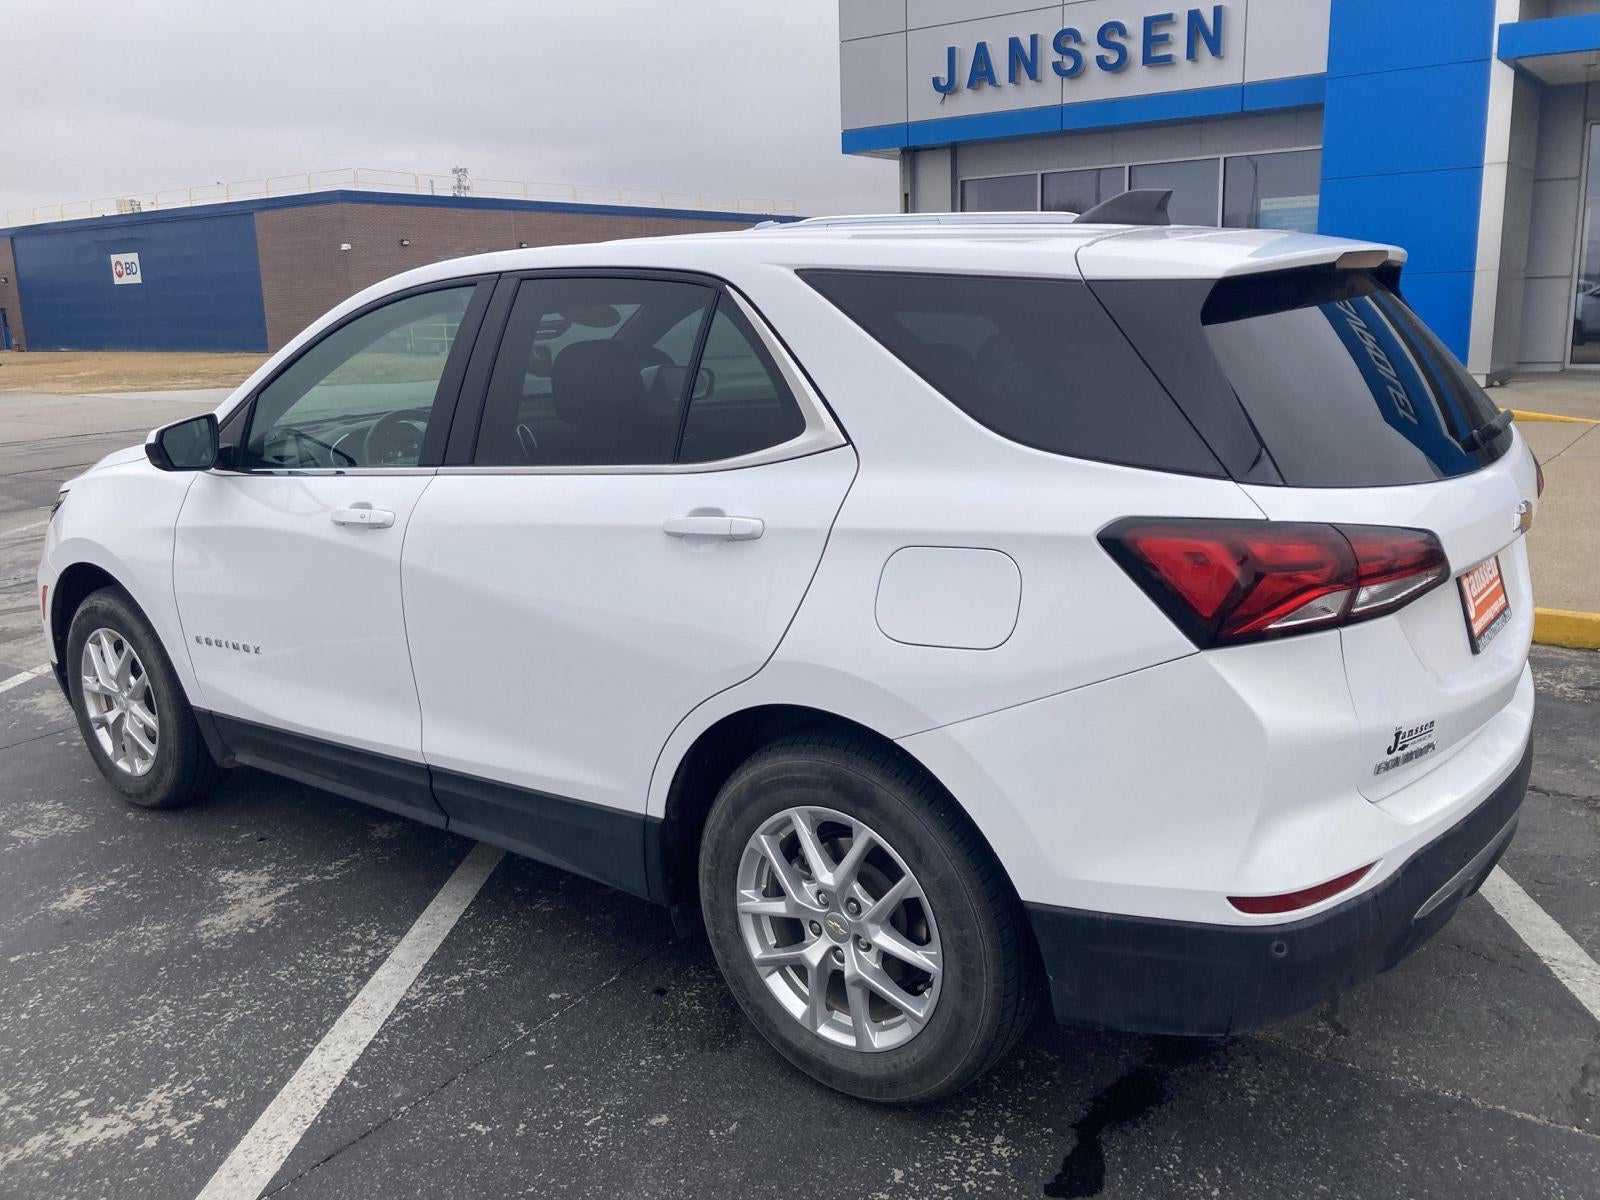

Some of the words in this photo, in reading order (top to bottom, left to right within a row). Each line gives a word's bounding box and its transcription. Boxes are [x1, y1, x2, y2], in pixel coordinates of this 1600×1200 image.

[932, 4, 1224, 94] JANSSEN
[125, 261, 138, 276] BD
[195, 635, 262, 655] EQUINOX
[1386, 720, 1435, 755] Janssen
